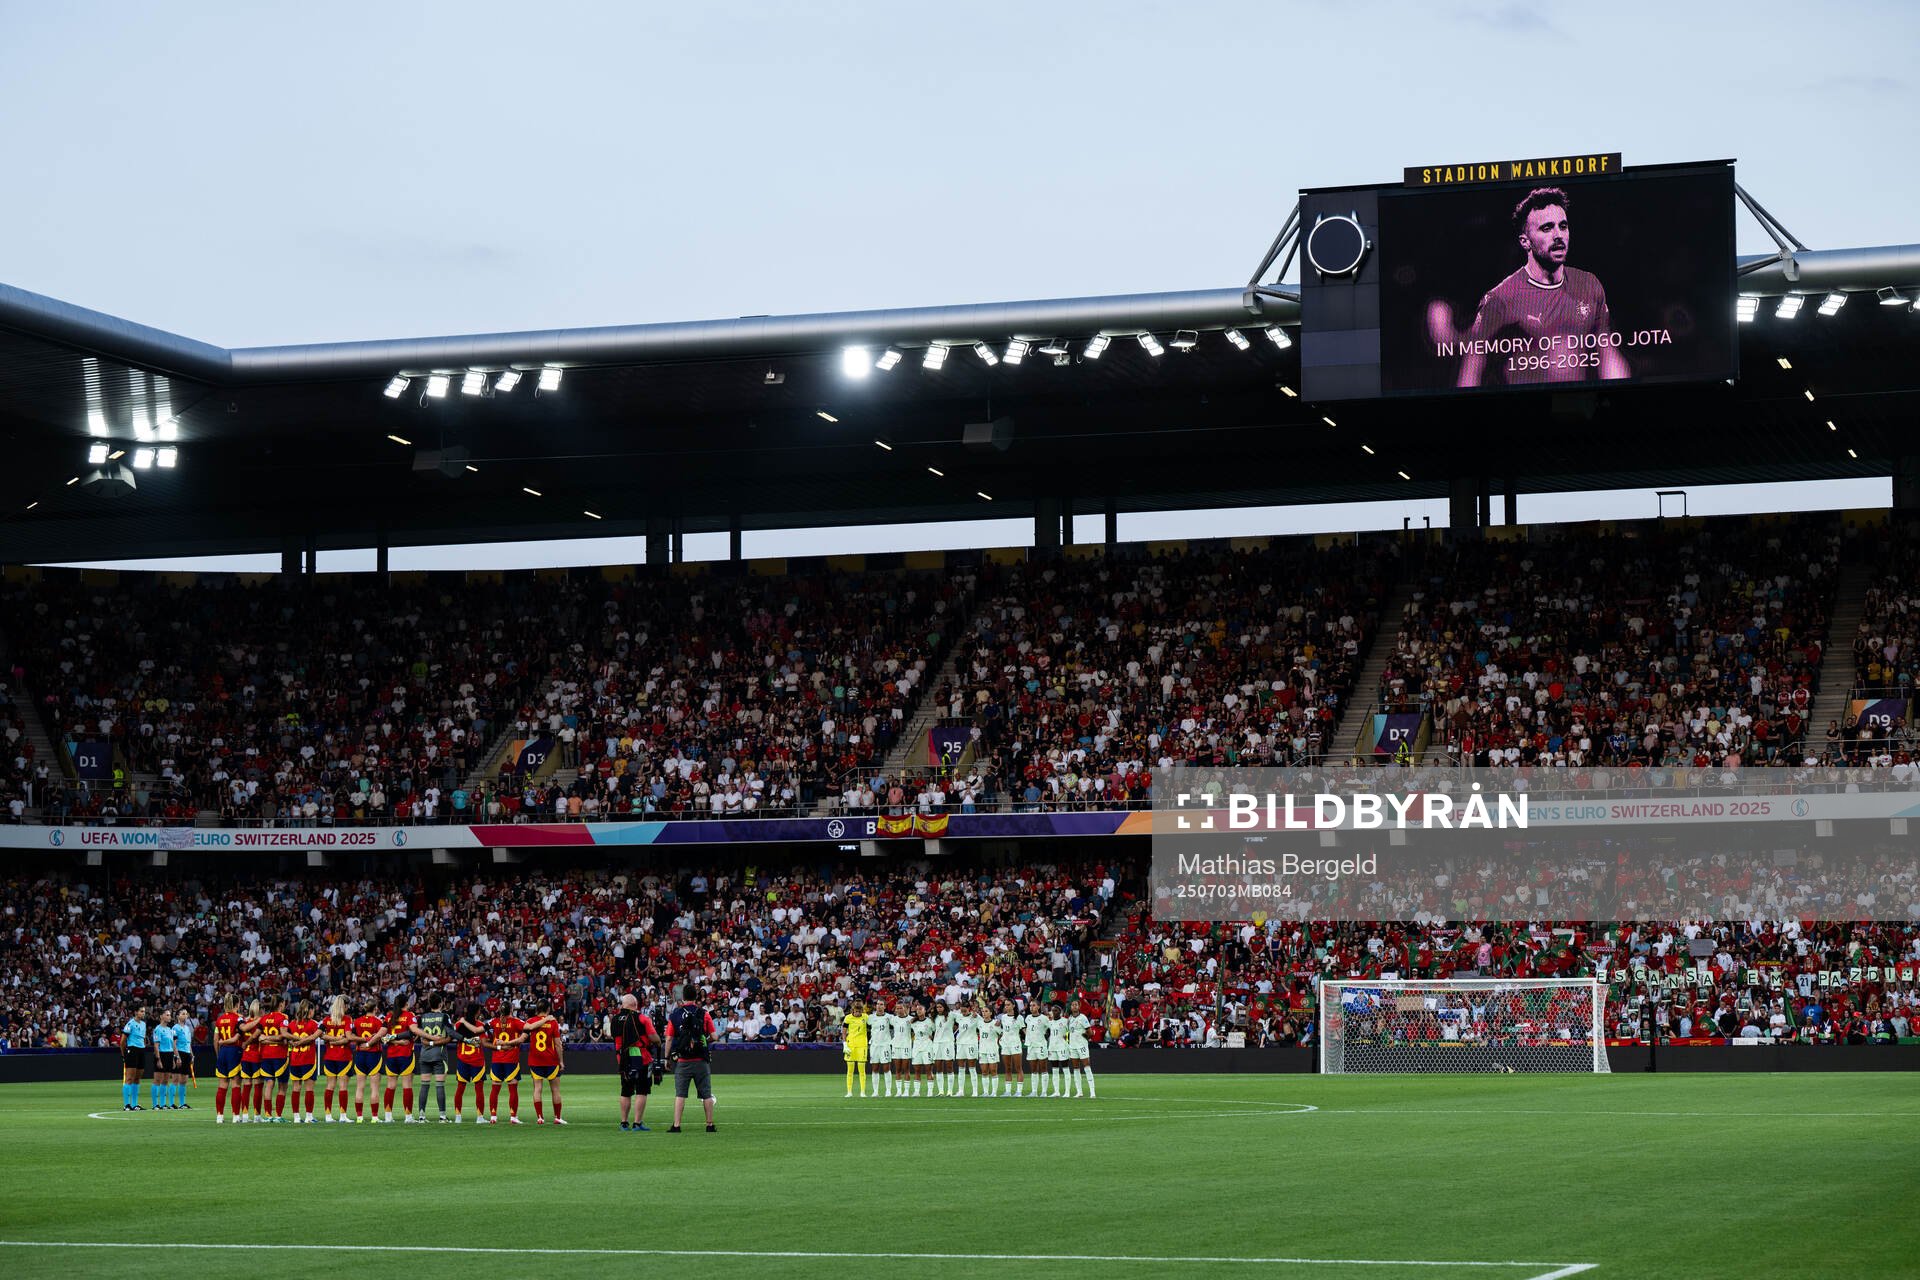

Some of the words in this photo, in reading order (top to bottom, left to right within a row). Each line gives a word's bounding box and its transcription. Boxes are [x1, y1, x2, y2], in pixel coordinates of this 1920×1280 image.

[1423, 164, 1499, 184] STADION
[1511, 156, 1609, 178] WANKDORF
[1437, 342, 1454, 357] IN
[1459, 337, 1534, 355] MEMORY
[1538, 335, 1562, 351] OF
[1567, 332, 1622, 349] DIOGO
[1627, 329, 1672, 346] JOTA
[1508, 352, 1601, 371] 1996-2025
[1389, 728, 1410, 740] D7
[79, 755, 98, 768] D1
[527, 752, 545, 765] D3
[1565, 806, 1607, 820] EURO
[1611, 802, 1725, 819] SWITZERLAND
[1729, 801, 1771, 816] 2025
[81, 832, 119, 845] UEFA
[194, 833, 231, 846] EURO
[234, 833, 337, 846] SWITZERLAND
[340, 832, 376, 845] 2025
[1800, 977, 1809, 987] 21
[220, 1026, 231, 1040] 11
[535, 1030, 548, 1052] 8
